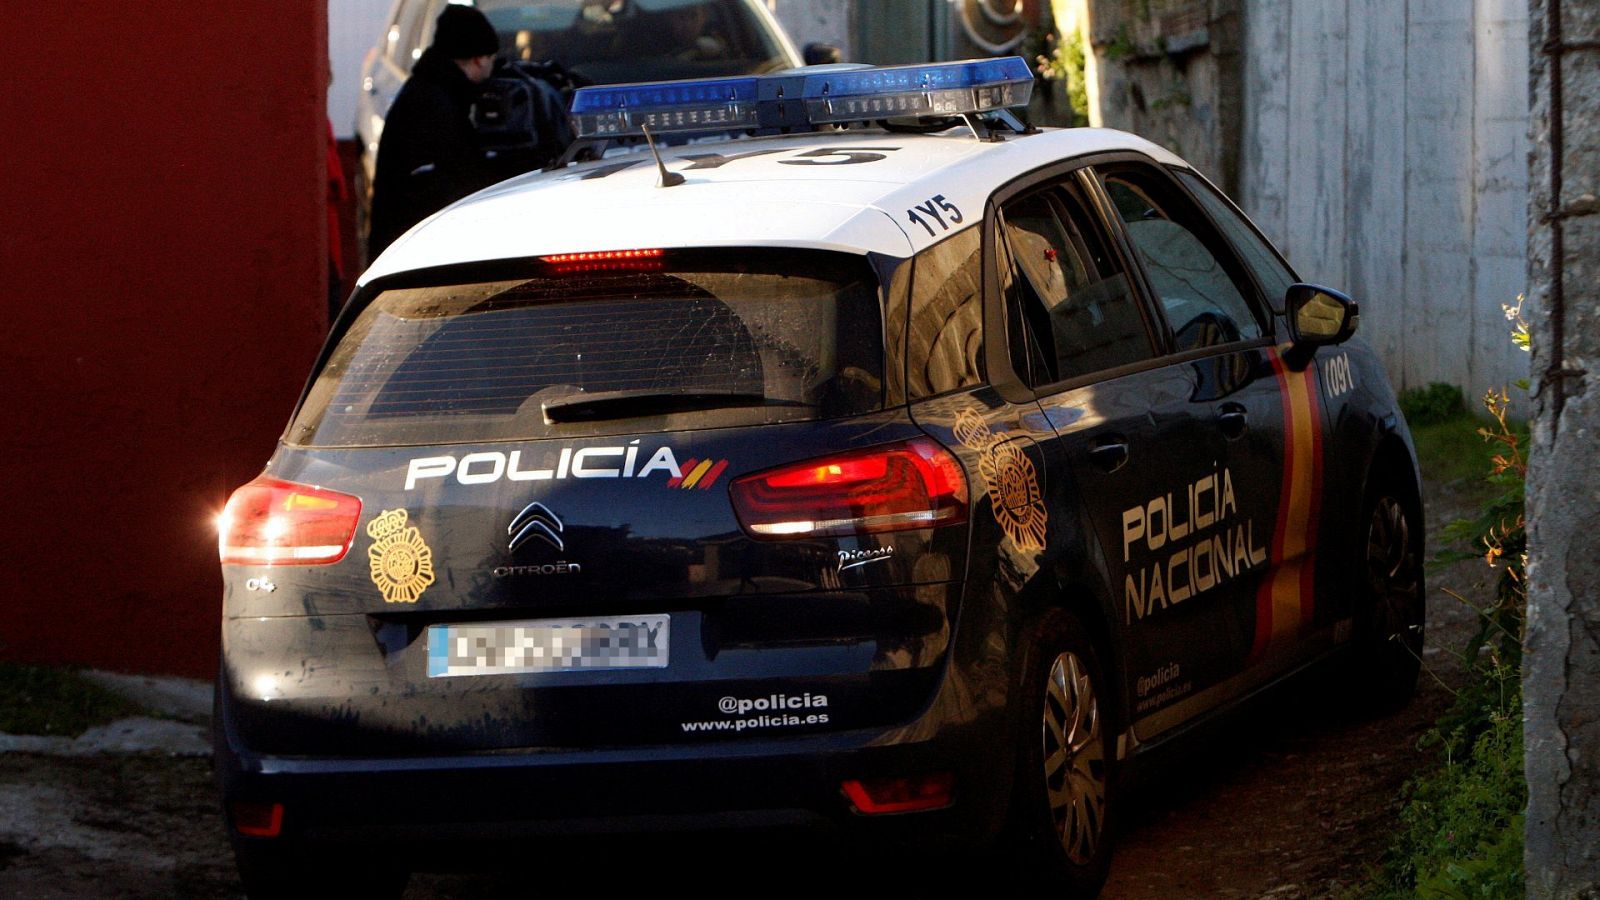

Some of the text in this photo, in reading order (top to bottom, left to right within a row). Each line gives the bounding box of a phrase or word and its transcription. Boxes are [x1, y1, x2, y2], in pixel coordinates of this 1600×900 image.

[906, 194, 964, 237] 1Y5
[1325, 351, 1354, 399] 1091
[404, 438, 684, 491] POLICÍA
[1125, 518, 1267, 626] NACIONAL
[1136, 661, 1180, 697] @policia
[681, 714, 830, 731] www.policia.es
[718, 693, 829, 715] @policia
